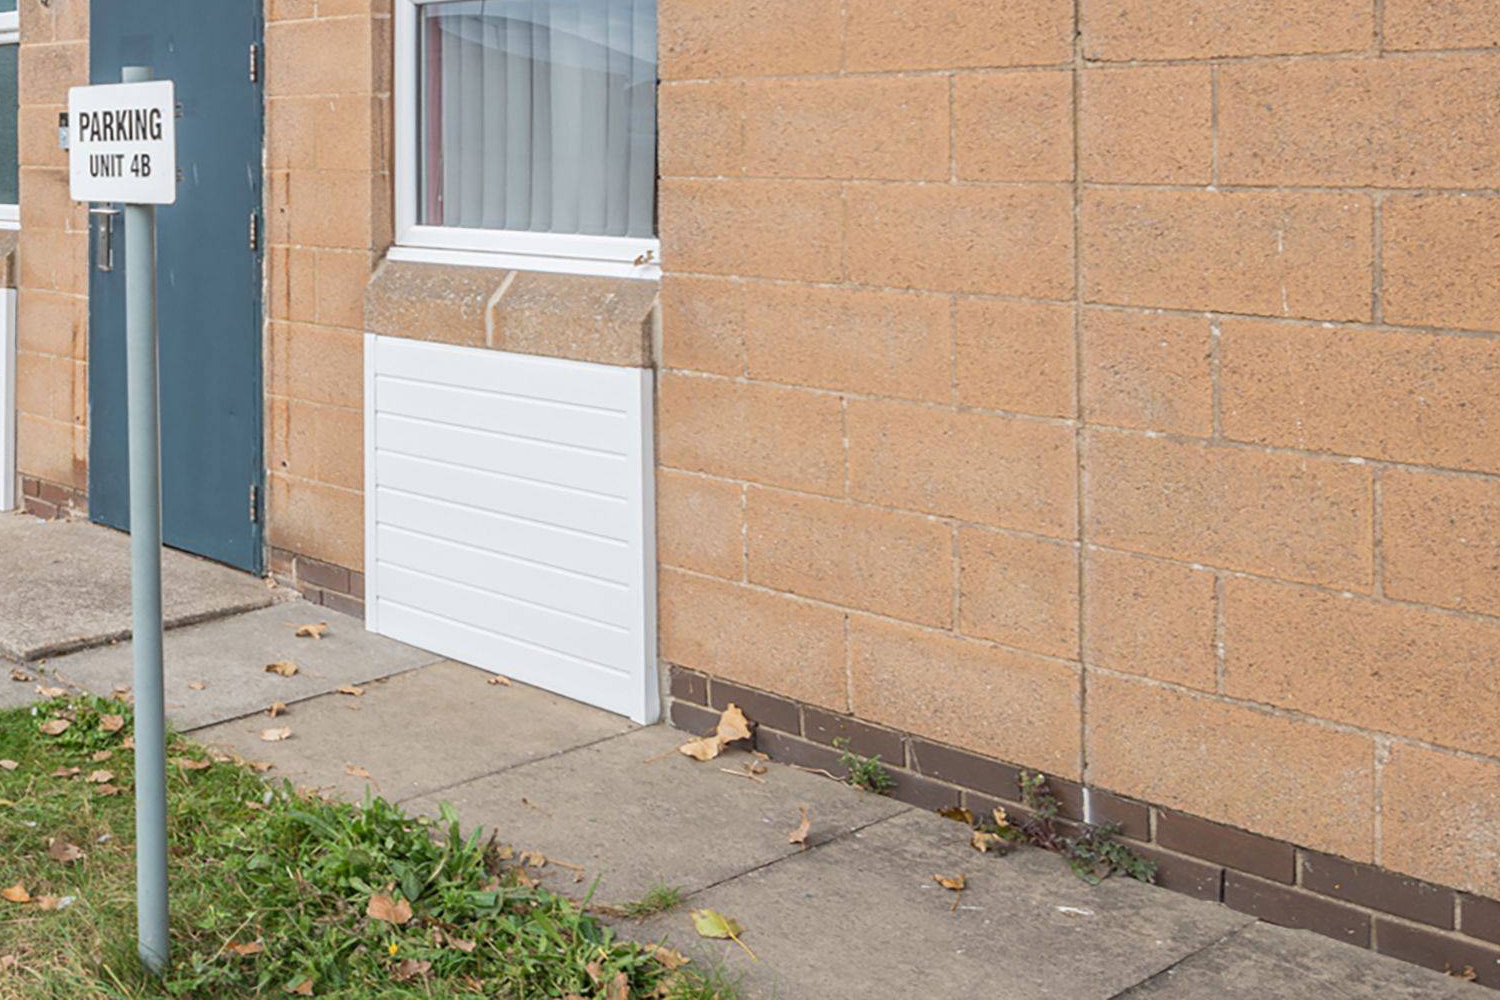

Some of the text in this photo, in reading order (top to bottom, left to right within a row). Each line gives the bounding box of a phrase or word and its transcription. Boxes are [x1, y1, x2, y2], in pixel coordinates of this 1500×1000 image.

[79, 107, 162, 142] PARKING
[90, 153, 151, 177] UNIT 4B
